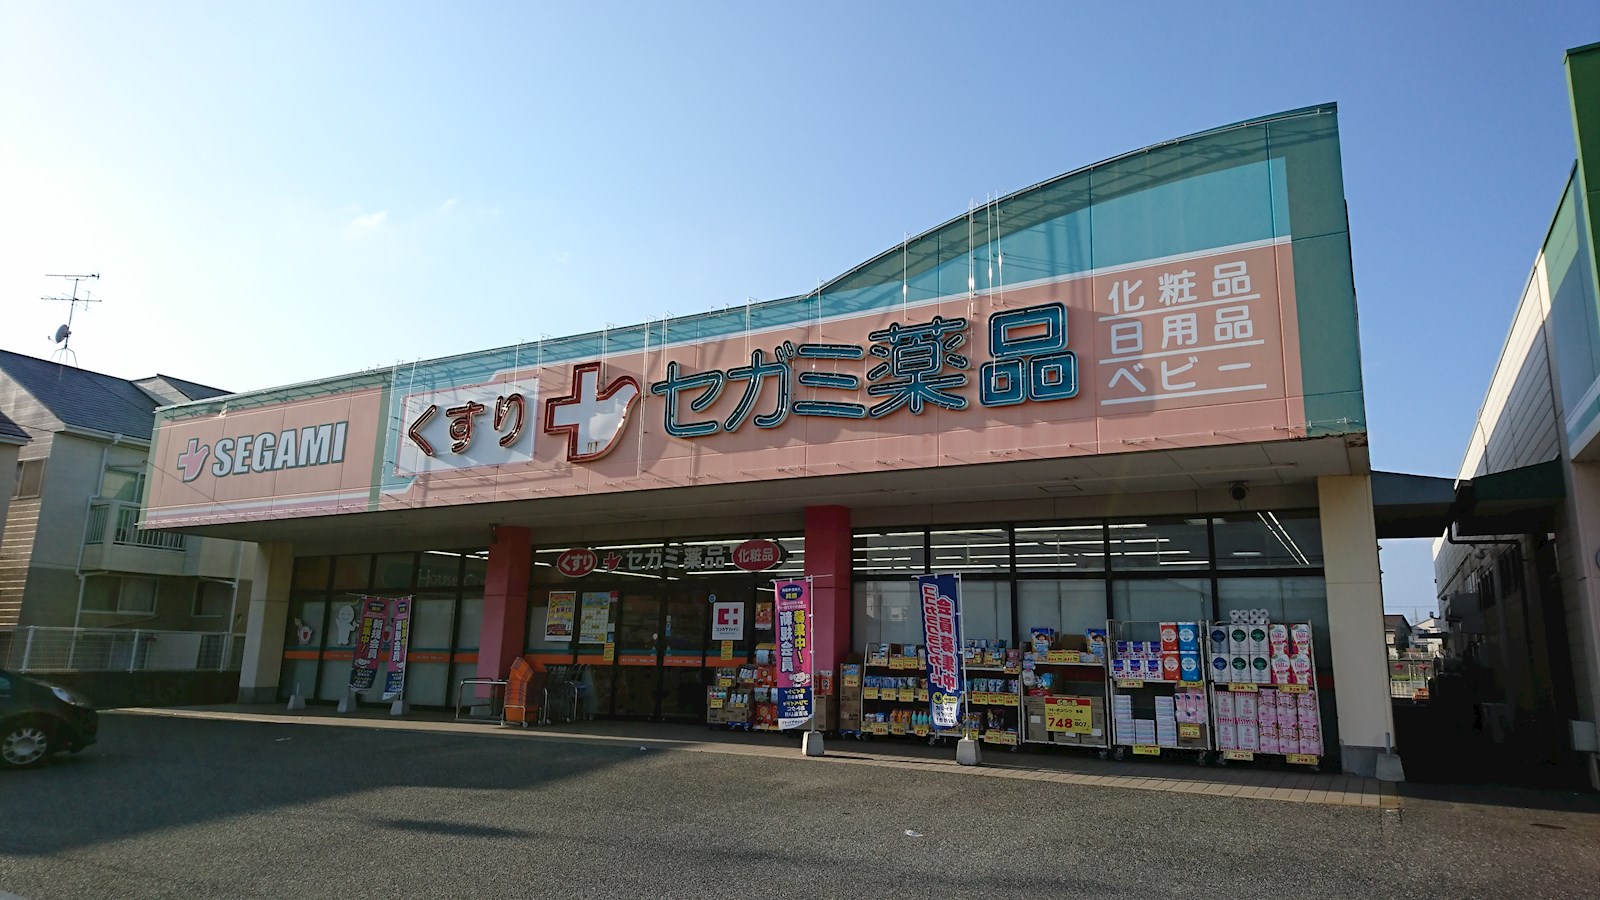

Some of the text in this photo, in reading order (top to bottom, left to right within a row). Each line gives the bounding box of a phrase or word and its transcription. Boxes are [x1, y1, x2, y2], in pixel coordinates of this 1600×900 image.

[1107, 259, 1252, 315] 化粧品
[1109, 304, 1254, 356] 日用品
[650, 302, 1081, 439] セガミ薬品
[1107, 356, 1254, 396] ベビー
[407, 391, 528, 458] くすり
[210, 421, 349, 478] SEGAMI
[560, 555, 594, 572] くすり
[626, 546, 726, 571] セガミ薬品
[737, 547, 774, 563] 化粧品
[1048, 717, 1073, 728] 748
